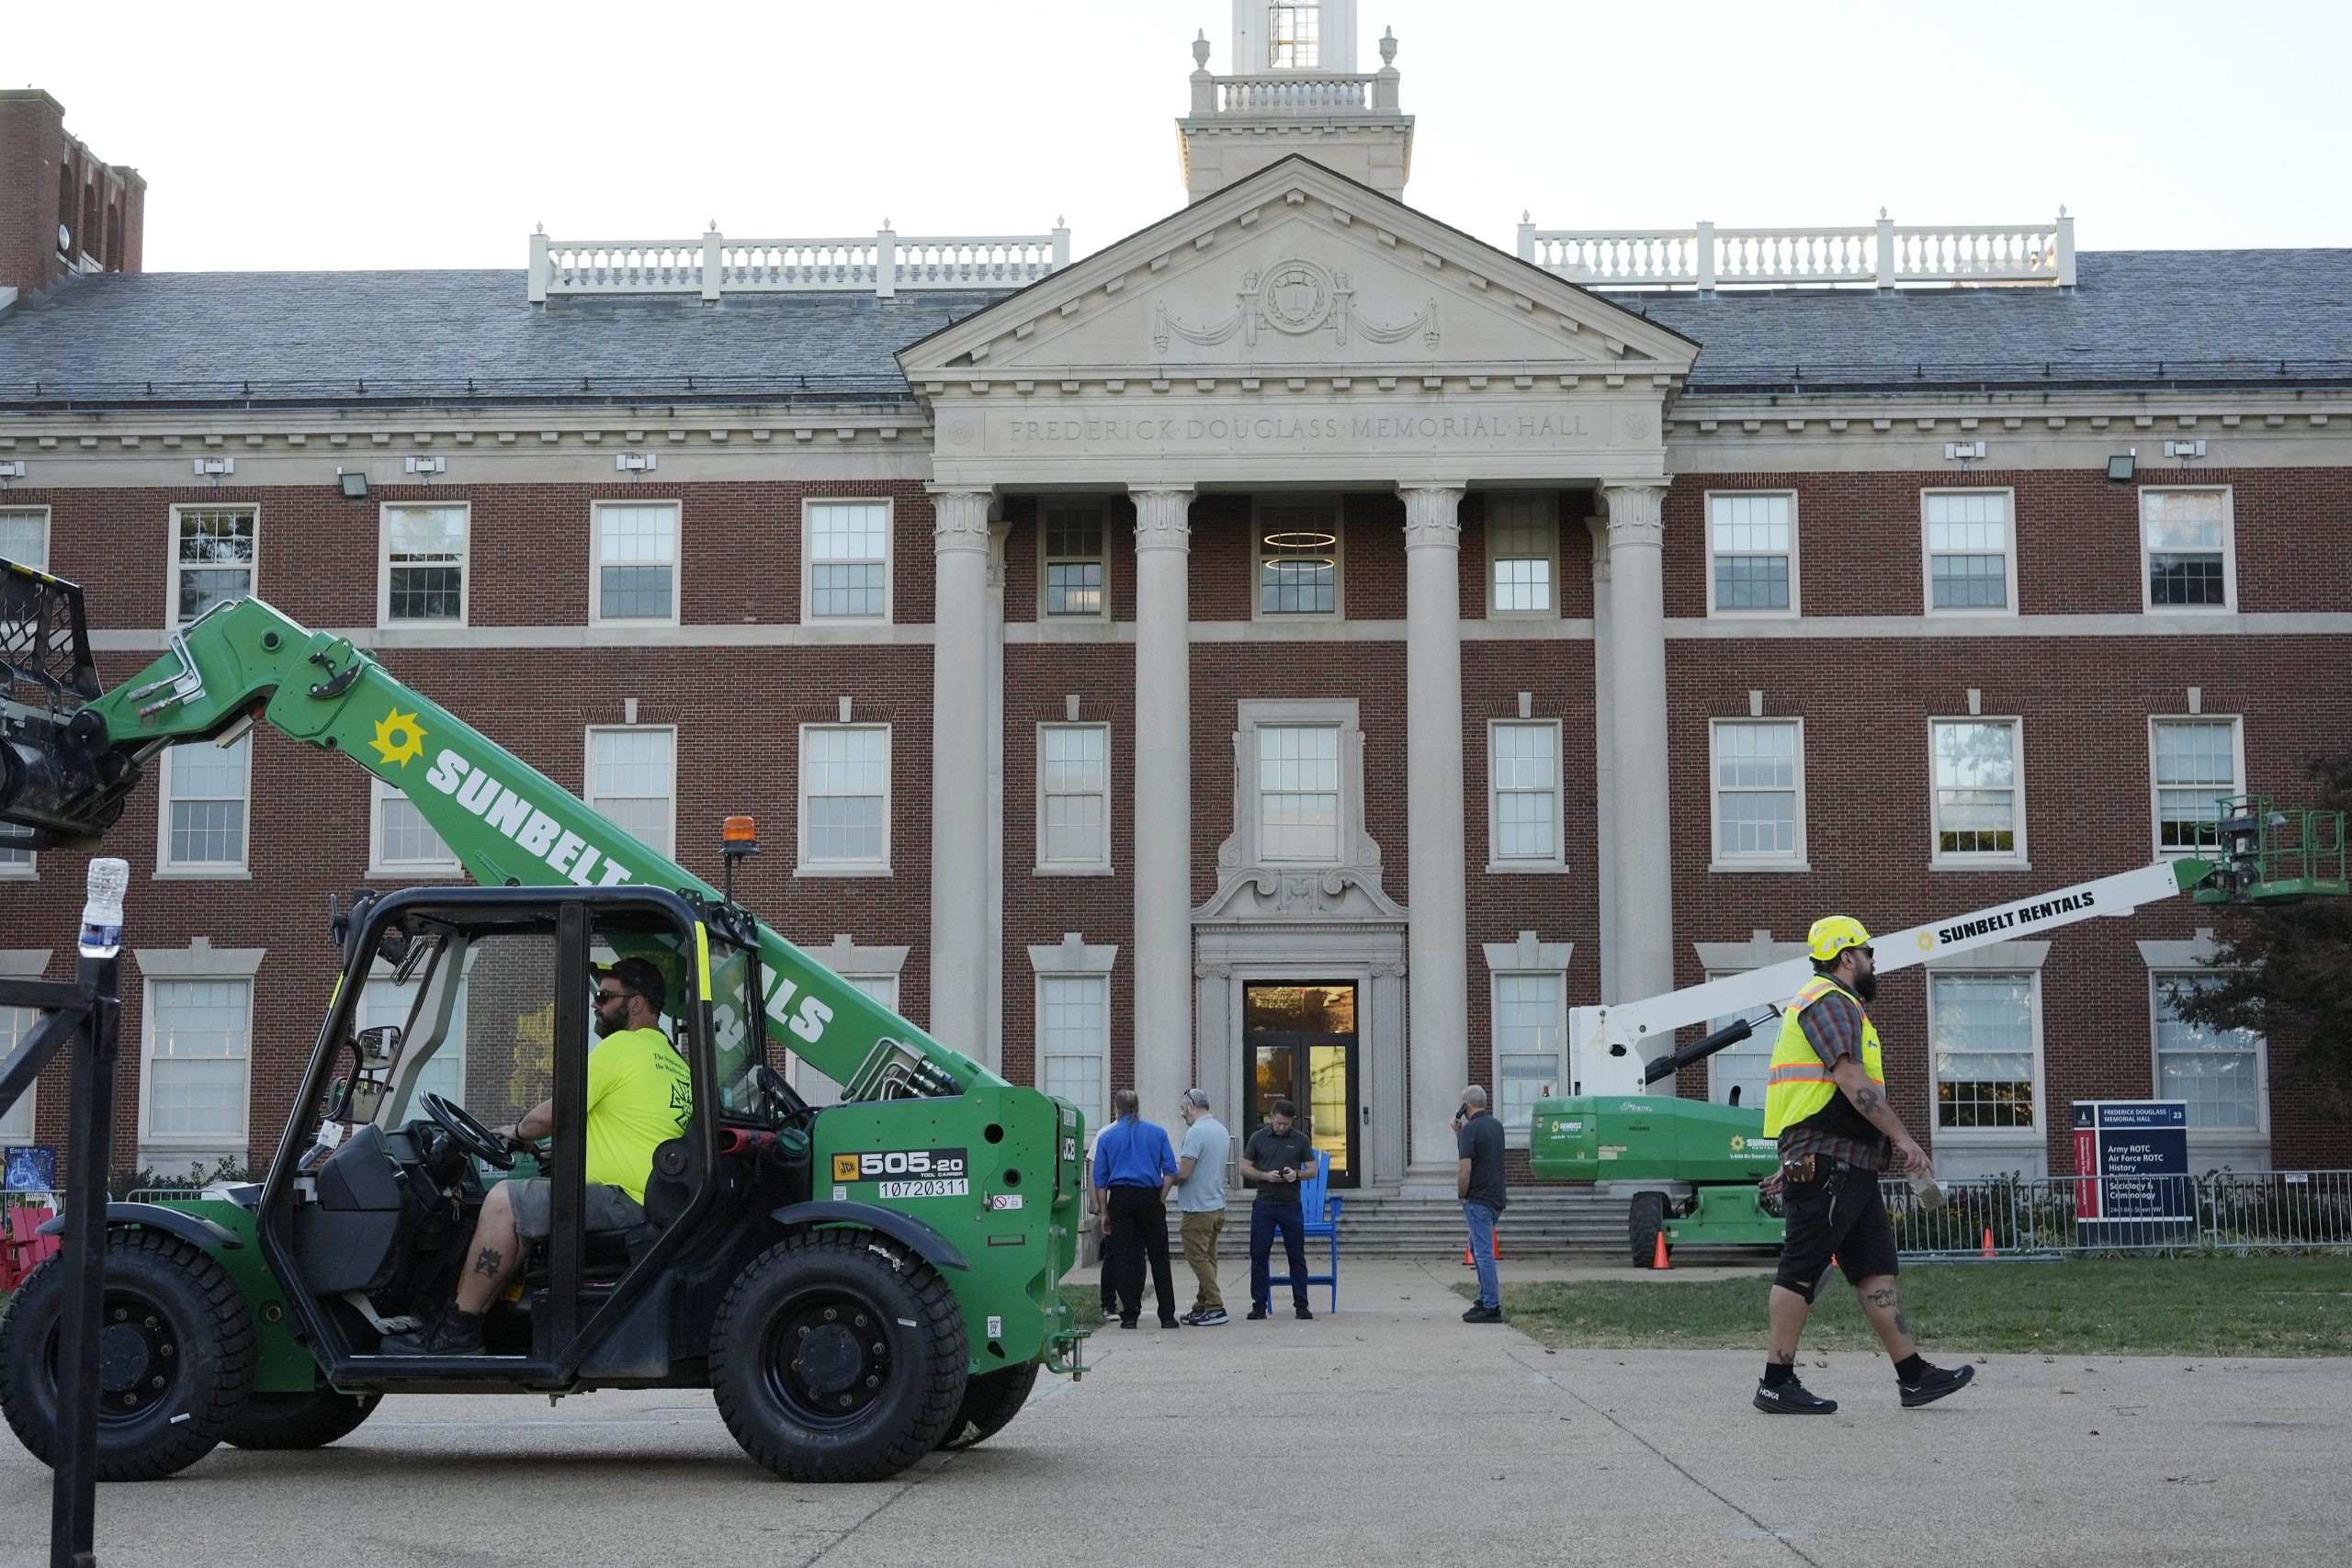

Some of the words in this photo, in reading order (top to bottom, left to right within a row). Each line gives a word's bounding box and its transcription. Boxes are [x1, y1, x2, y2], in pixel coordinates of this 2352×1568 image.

[1010, 420, 1175, 441] FREDERICK
[1186, 419, 1338, 439] DOUGLASS
[1351, 417, 1507, 438] MEMORIAL
[1517, 415, 1589, 436] HALL
[425, 749, 632, 886] SUNBELT
[1939, 911, 2014, 944] SUNBELT
[2018, 891, 2095, 923] RENTALS
[1063, 1137, 1076, 1161] JCB
[2108, 1145, 2128, 1154] Army
[2130, 1145, 2151, 1153] ROTC
[840, 1161, 856, 1175] JCB
[2109, 1164, 2136, 1172] History
[881, 1179, 966, 1197] 10720311
[1758, 1387, 1780, 1401] HOKA
